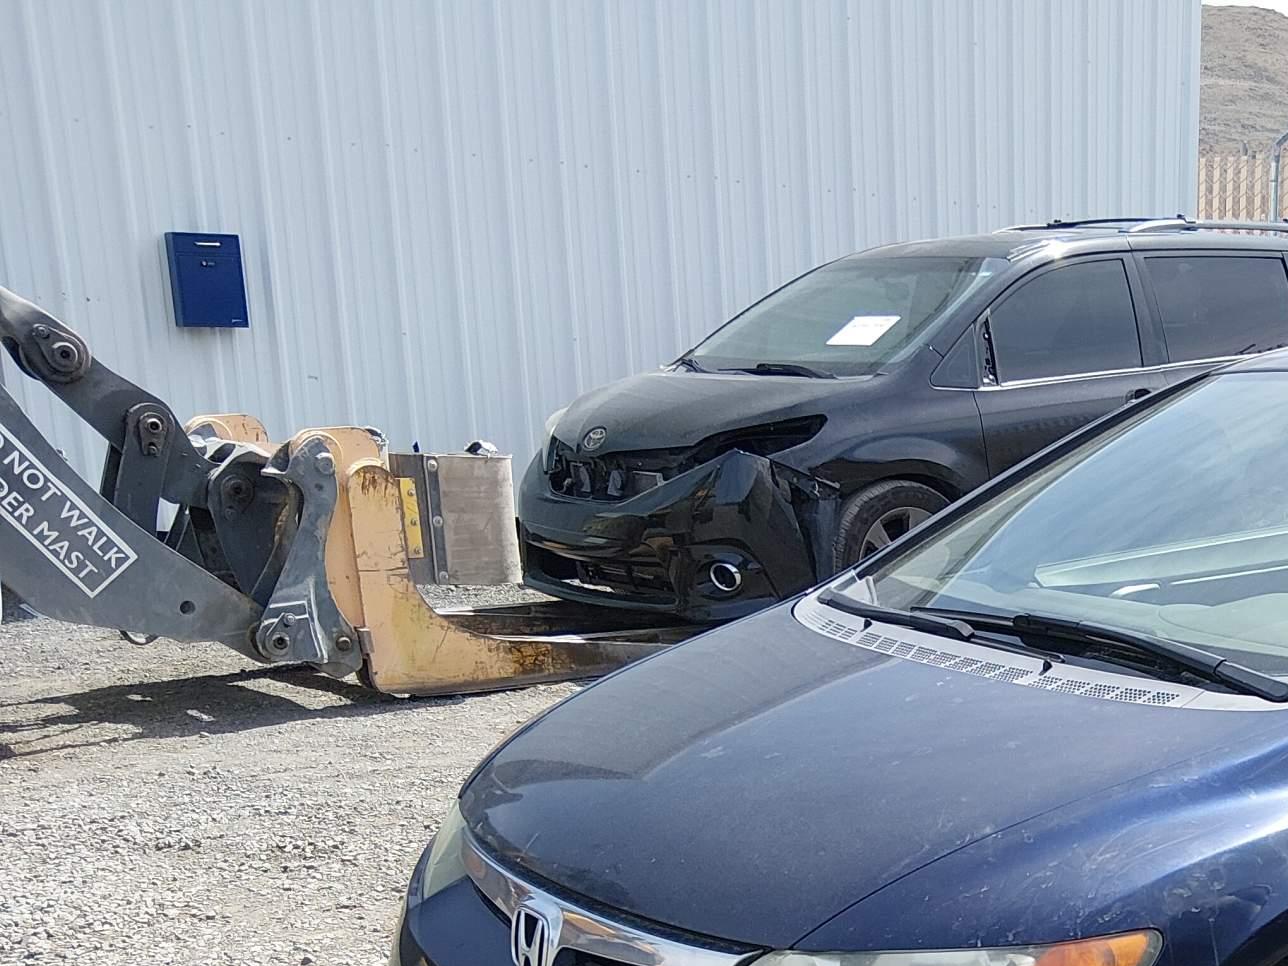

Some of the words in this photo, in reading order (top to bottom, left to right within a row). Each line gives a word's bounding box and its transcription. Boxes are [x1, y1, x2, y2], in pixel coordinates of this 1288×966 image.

[2, 450, 62, 501] NOT
[60, 500, 126, 569] WALK
[32, 520, 99, 578] MAST
